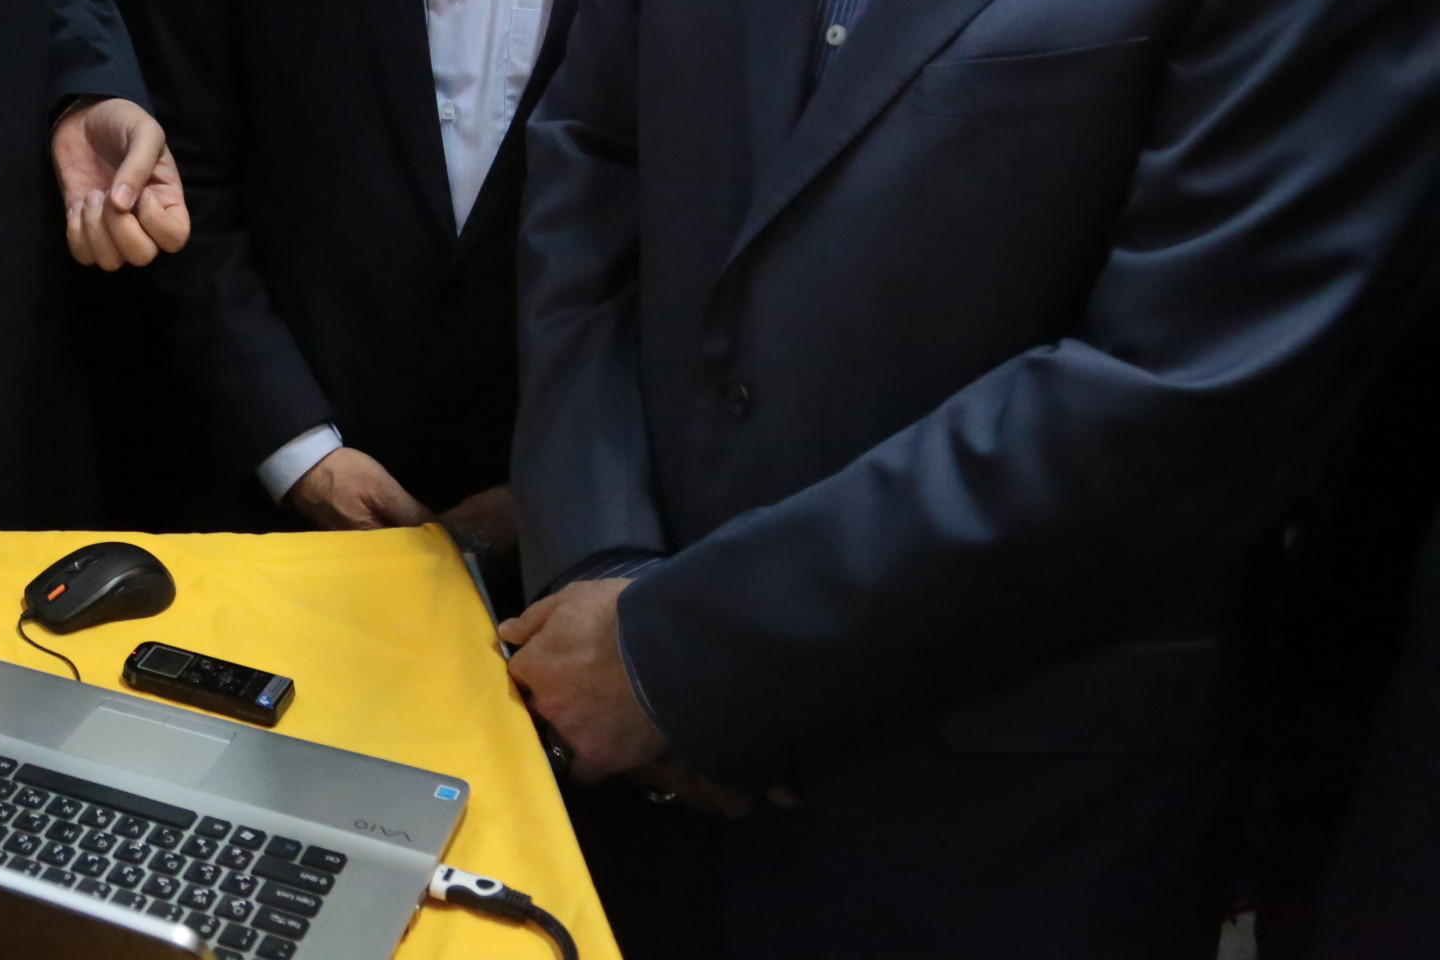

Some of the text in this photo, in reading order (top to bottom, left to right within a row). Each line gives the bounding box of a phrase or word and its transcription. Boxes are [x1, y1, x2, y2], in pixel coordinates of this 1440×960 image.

[29, 795, 41, 804] M
[62, 805, 74, 815] N
[33, 820, 41, 828] J
[63, 829, 75, 838] H
[129, 825, 139, 834] V
[165, 835, 174, 843] C
[21, 841, 33, 850] U
[325, 855, 341, 863] Ctrl
[90, 863, 98, 872] T
[167, 861, 178, 869] D
[126, 874, 137, 882] R
[300, 872, 319, 882] Shift
[240, 882, 251, 890] A
[193, 895, 207, 904] W
[276, 890, 316, 907] Caps Lock
[233, 907, 244, 915] Q
[288, 920, 302, 929] Tab
